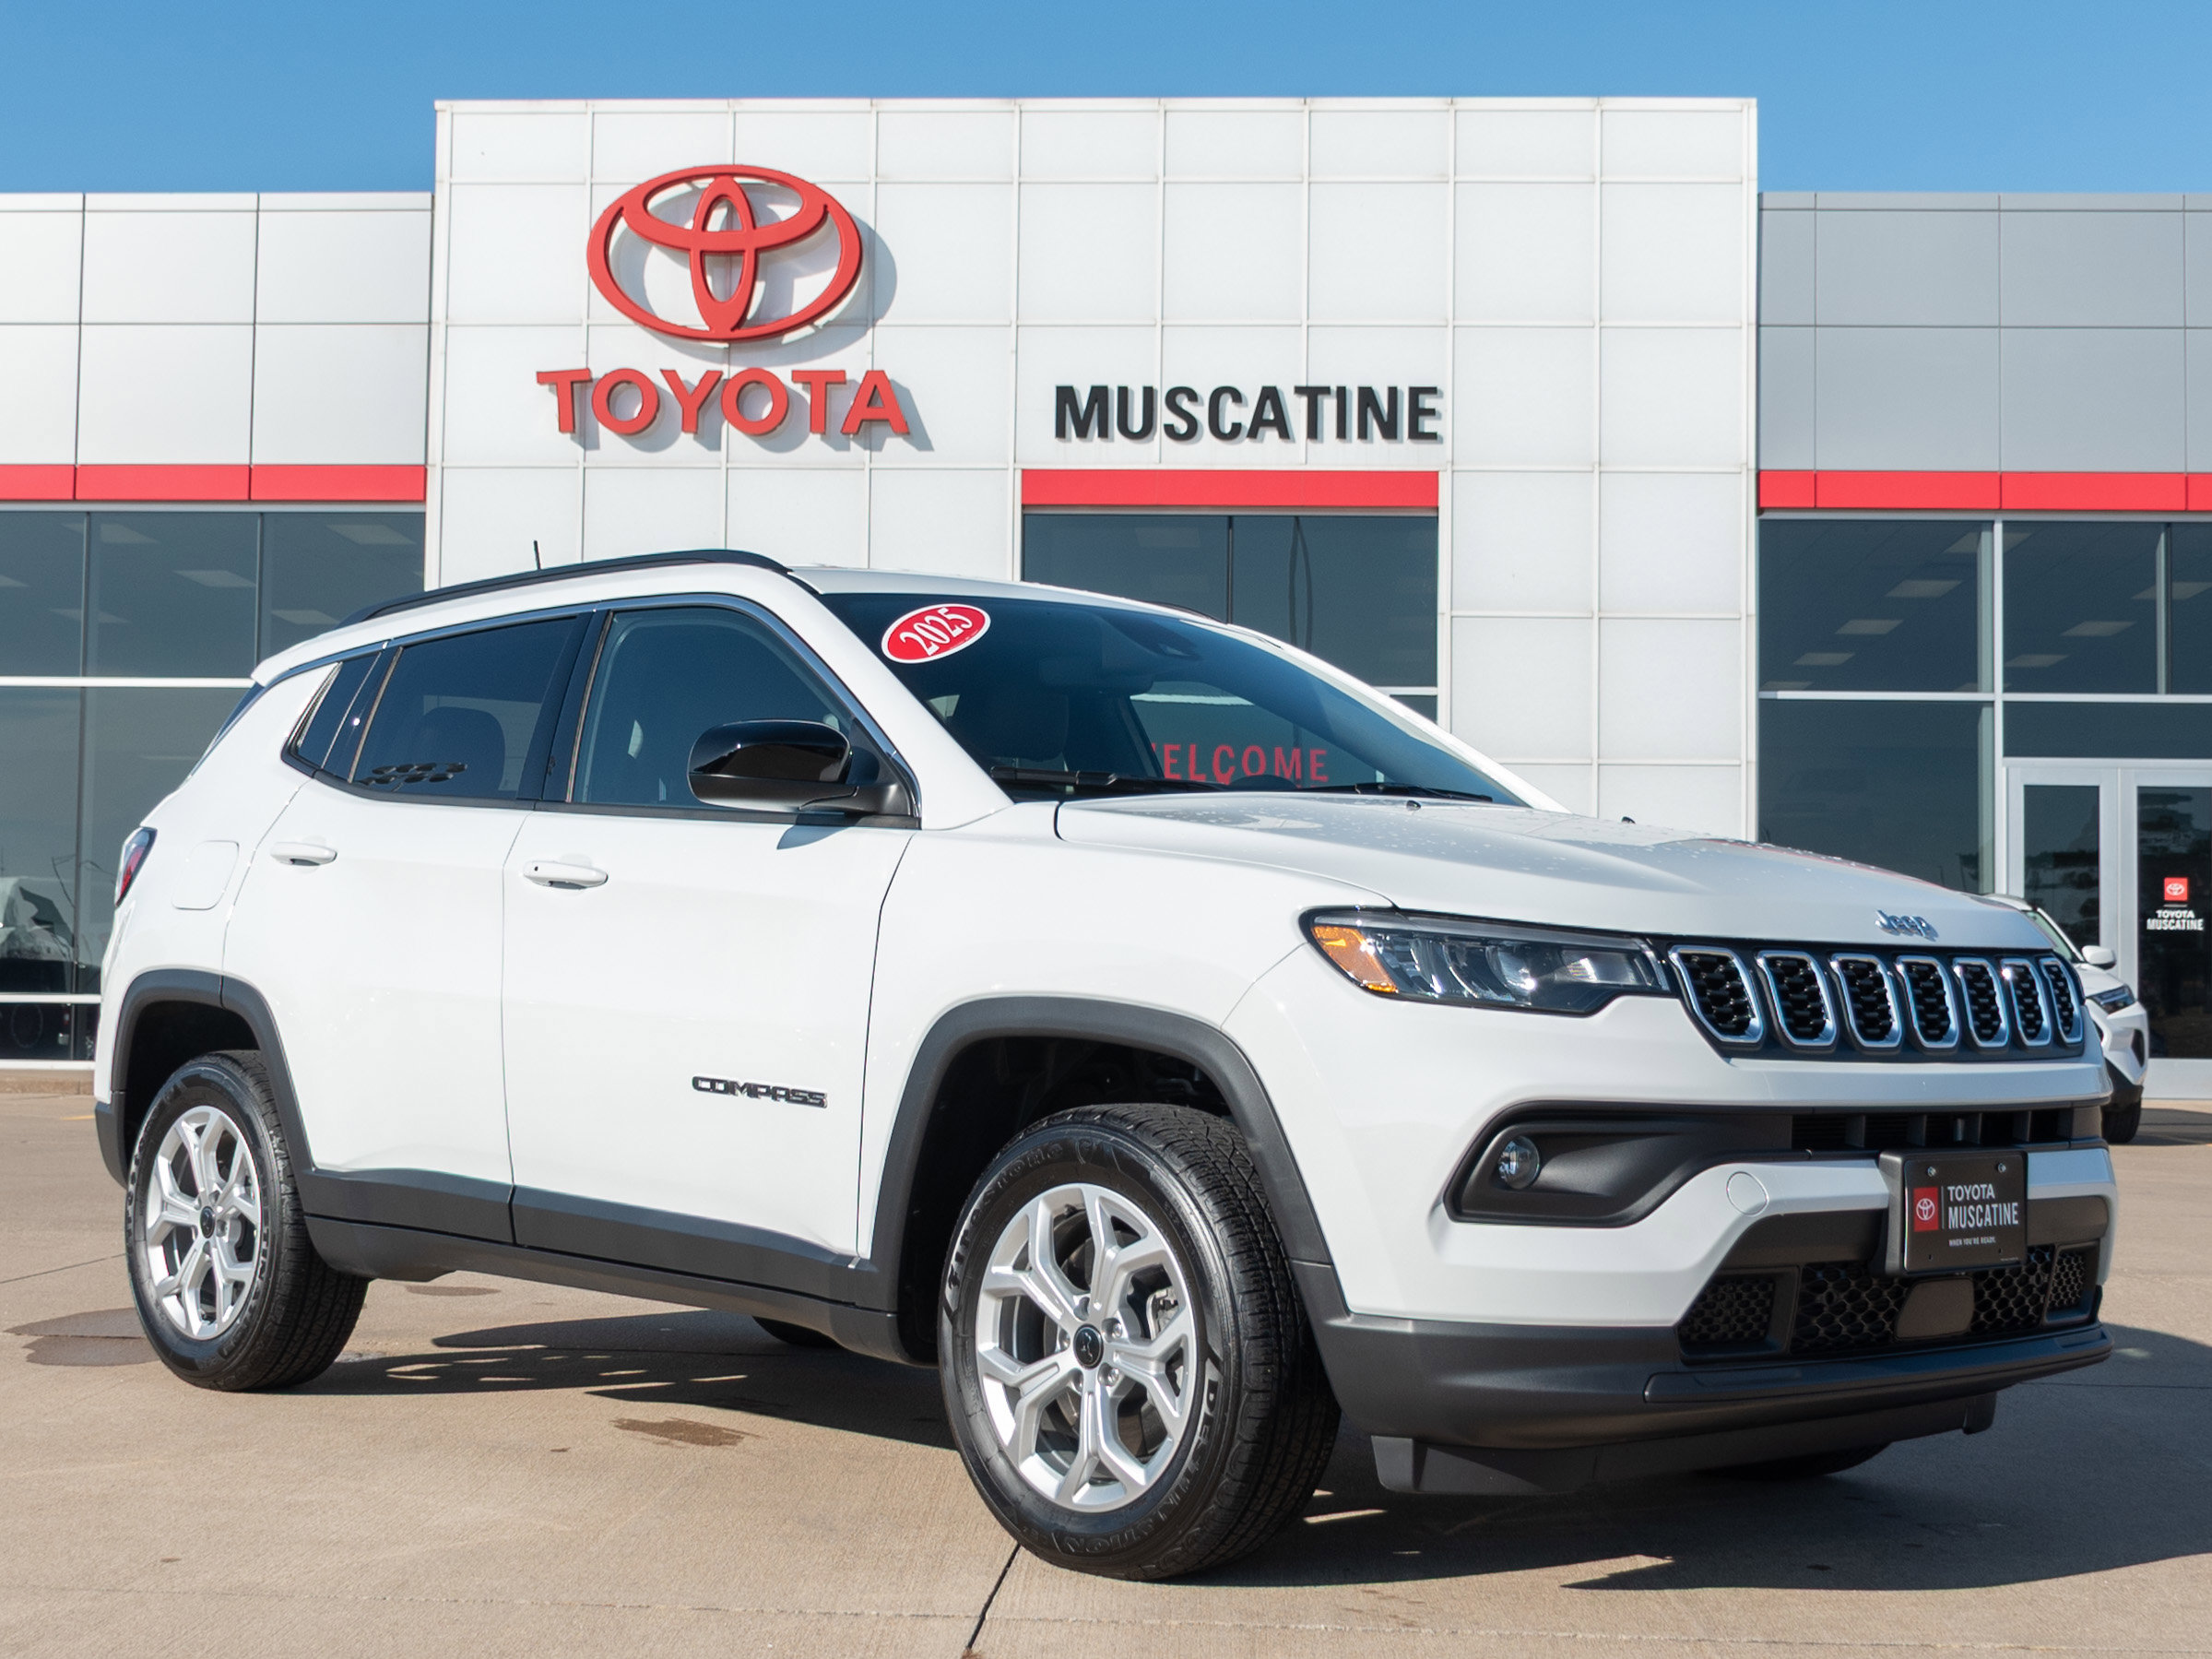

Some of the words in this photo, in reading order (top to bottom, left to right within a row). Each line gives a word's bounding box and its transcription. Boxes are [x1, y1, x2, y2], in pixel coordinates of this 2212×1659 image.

[536, 367, 911, 436] TOYOTA
[1055, 385, 1439, 441] MUSCATINE
[899, 607, 972, 656] 2025
[1151, 743, 1329, 786] ELCOME
[1875, 909, 1939, 942] Jeep
[2147, 918, 2204, 930] MUSCATINE
[2156, 909, 2195, 918] TOYOTA
[692, 1075, 828, 1108] COMPASS
[1947, 1184, 1995, 1202] TOYOTA
[1948, 1202, 2018, 1229] MUSCATINE
